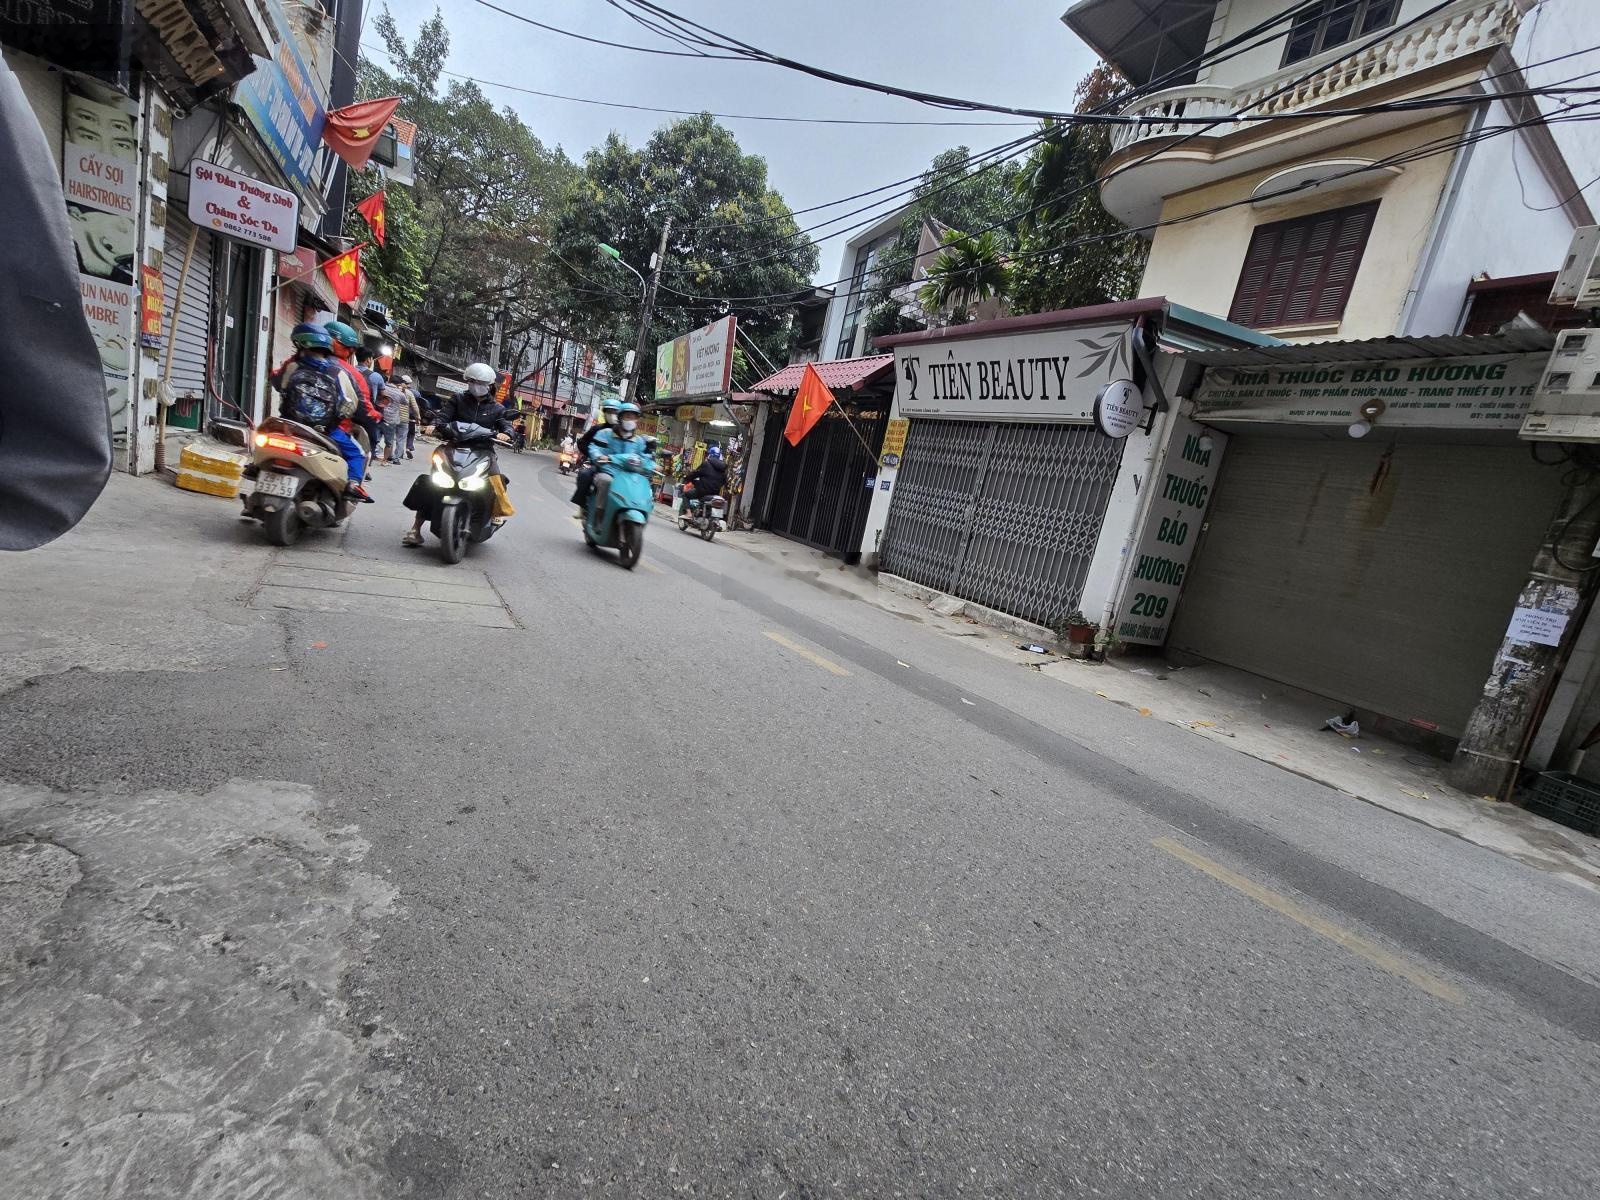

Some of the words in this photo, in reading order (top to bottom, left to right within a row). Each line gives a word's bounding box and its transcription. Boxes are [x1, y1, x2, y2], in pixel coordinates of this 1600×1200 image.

[80, 152, 103, 177] CẤY
[105, 164, 124, 186] SỢI
[69, 179, 132, 212] HAIRSTROKES
[196, 166, 213, 181] Gội
[215, 172, 237, 189] Đầu
[239, 181, 272, 203] Dưỡng
[272, 193, 293, 209] Sinh
[237, 196, 251, 209] &
[206, 202, 238, 221] Chăm
[240, 213, 260, 228] Sóc
[262, 220, 279, 234] Da
[100, 285, 128, 307] NANO
[928, 349, 972, 400] TIÊN
[977, 356, 1070, 401] BEAUTY
[1231, 368, 1269, 385] NHÀ
[1276, 365, 1345, 384] THUỐC
[1407, 363, 1508, 382] HƯƠNG
[1322, 385, 1350, 397] PHẨM
[1351, 385, 1376, 397] CHỨC
[1378, 385, 1408, 397] NĂNG
[1418, 386, 1453, 397] TRANG
[1456, 384, 1489, 397] THIẾT
[1491, 386, 1504, 399] BỊ
[1508, 386, 1517, 396] Y
[1519, 382, 1537, 396] TẾ
[1162, 474, 1208, 509] THUỐC
[1157, 510, 1189, 546] BẢO
[1135, 554, 1185, 586] HƯƠNG
[1130, 592, 1169, 619] 209
